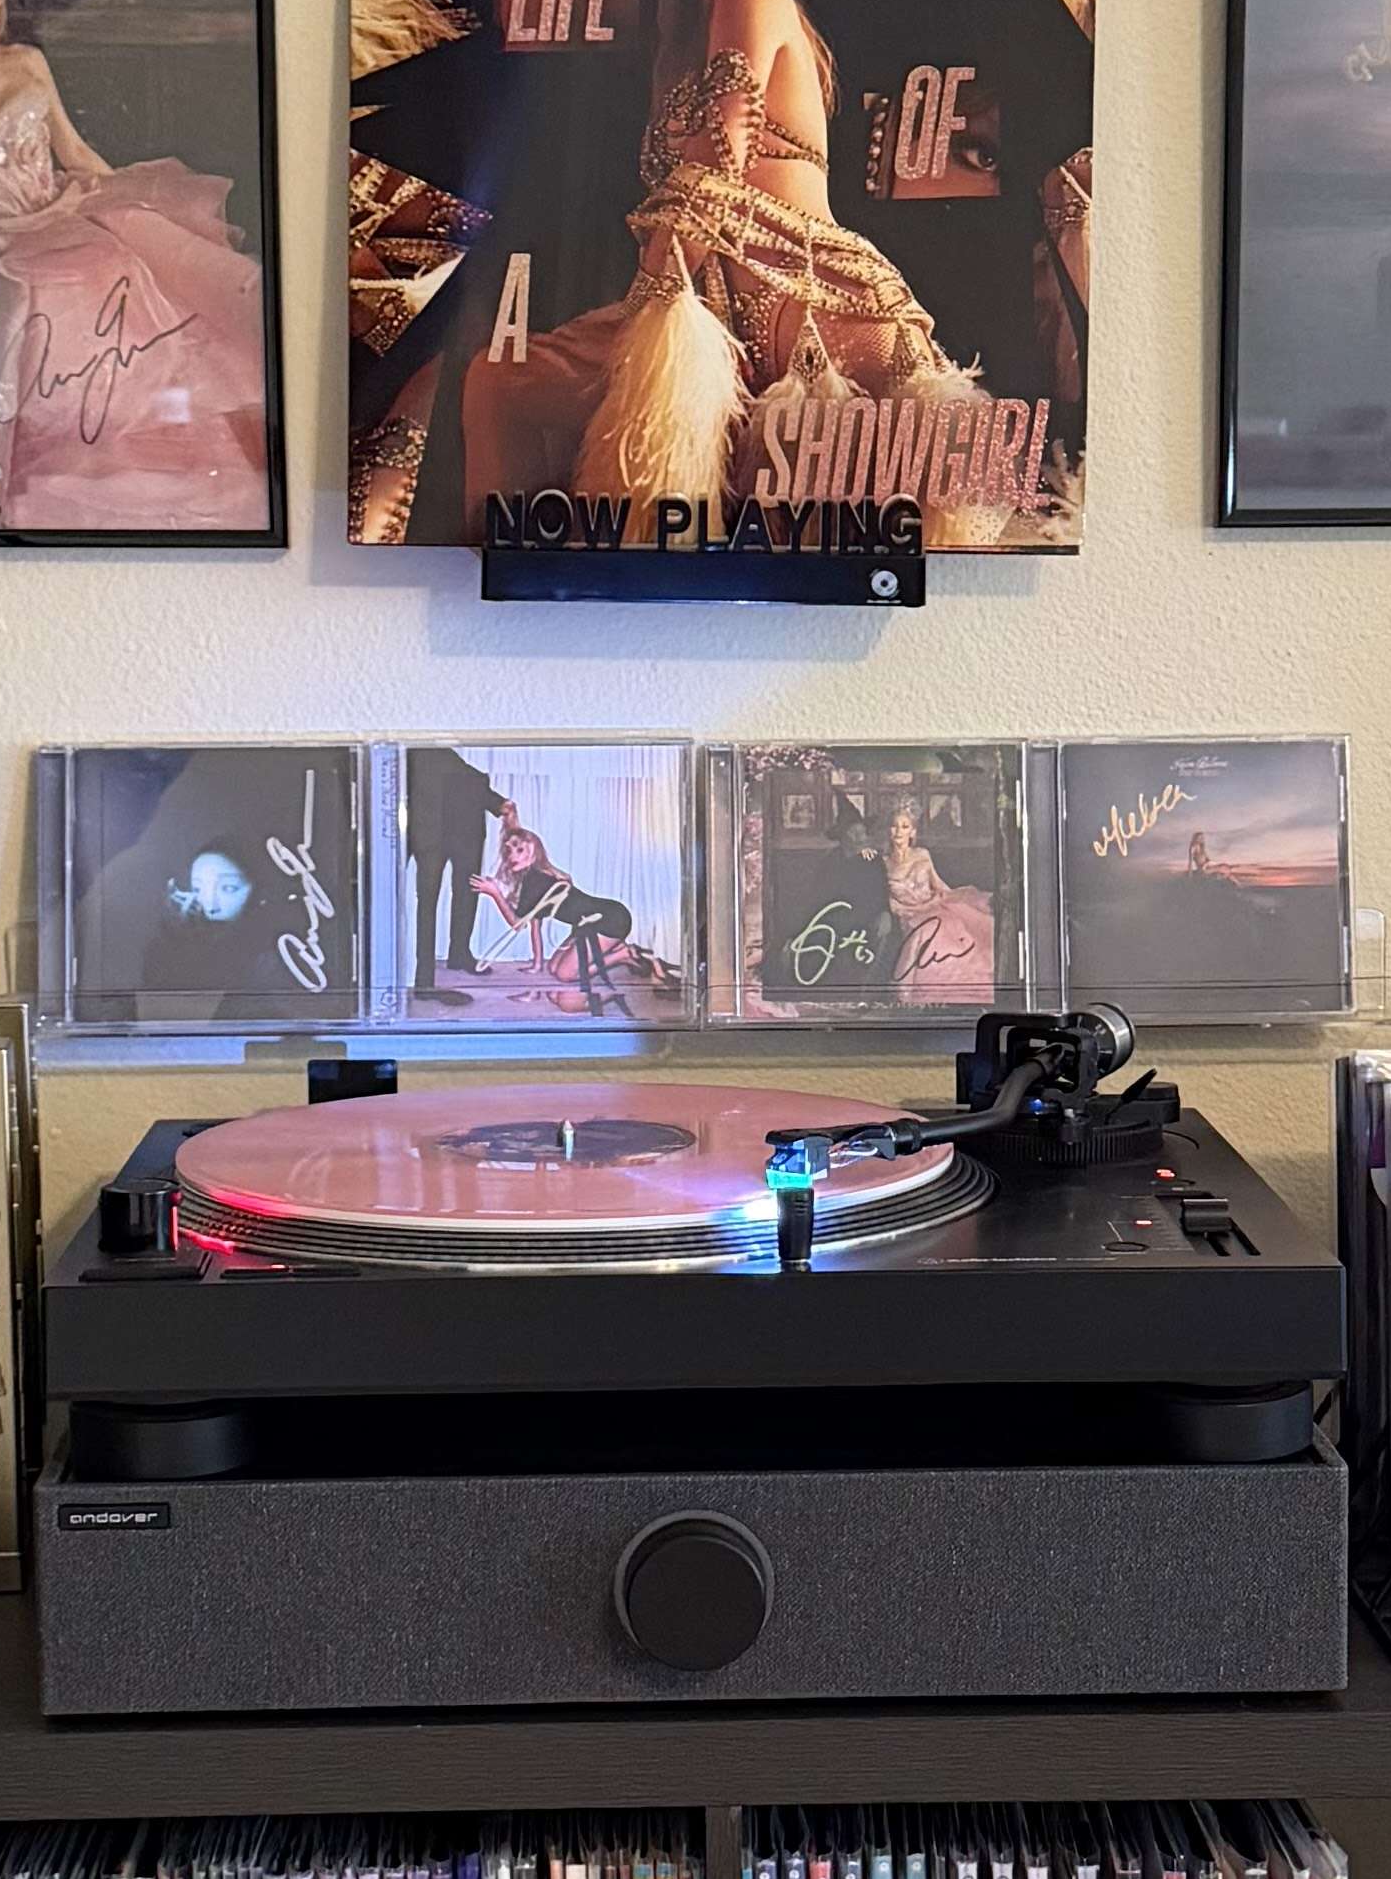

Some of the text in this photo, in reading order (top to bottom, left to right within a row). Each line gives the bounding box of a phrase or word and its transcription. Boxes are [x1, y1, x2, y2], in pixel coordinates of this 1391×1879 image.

[894, 64, 977, 181] OF
[486, 252, 532, 364] A
[753, 395, 1053, 511] SHOWGIRL
[484, 488, 923, 555] NOW PLAYING
[69, 1512, 159, 1524] andover
